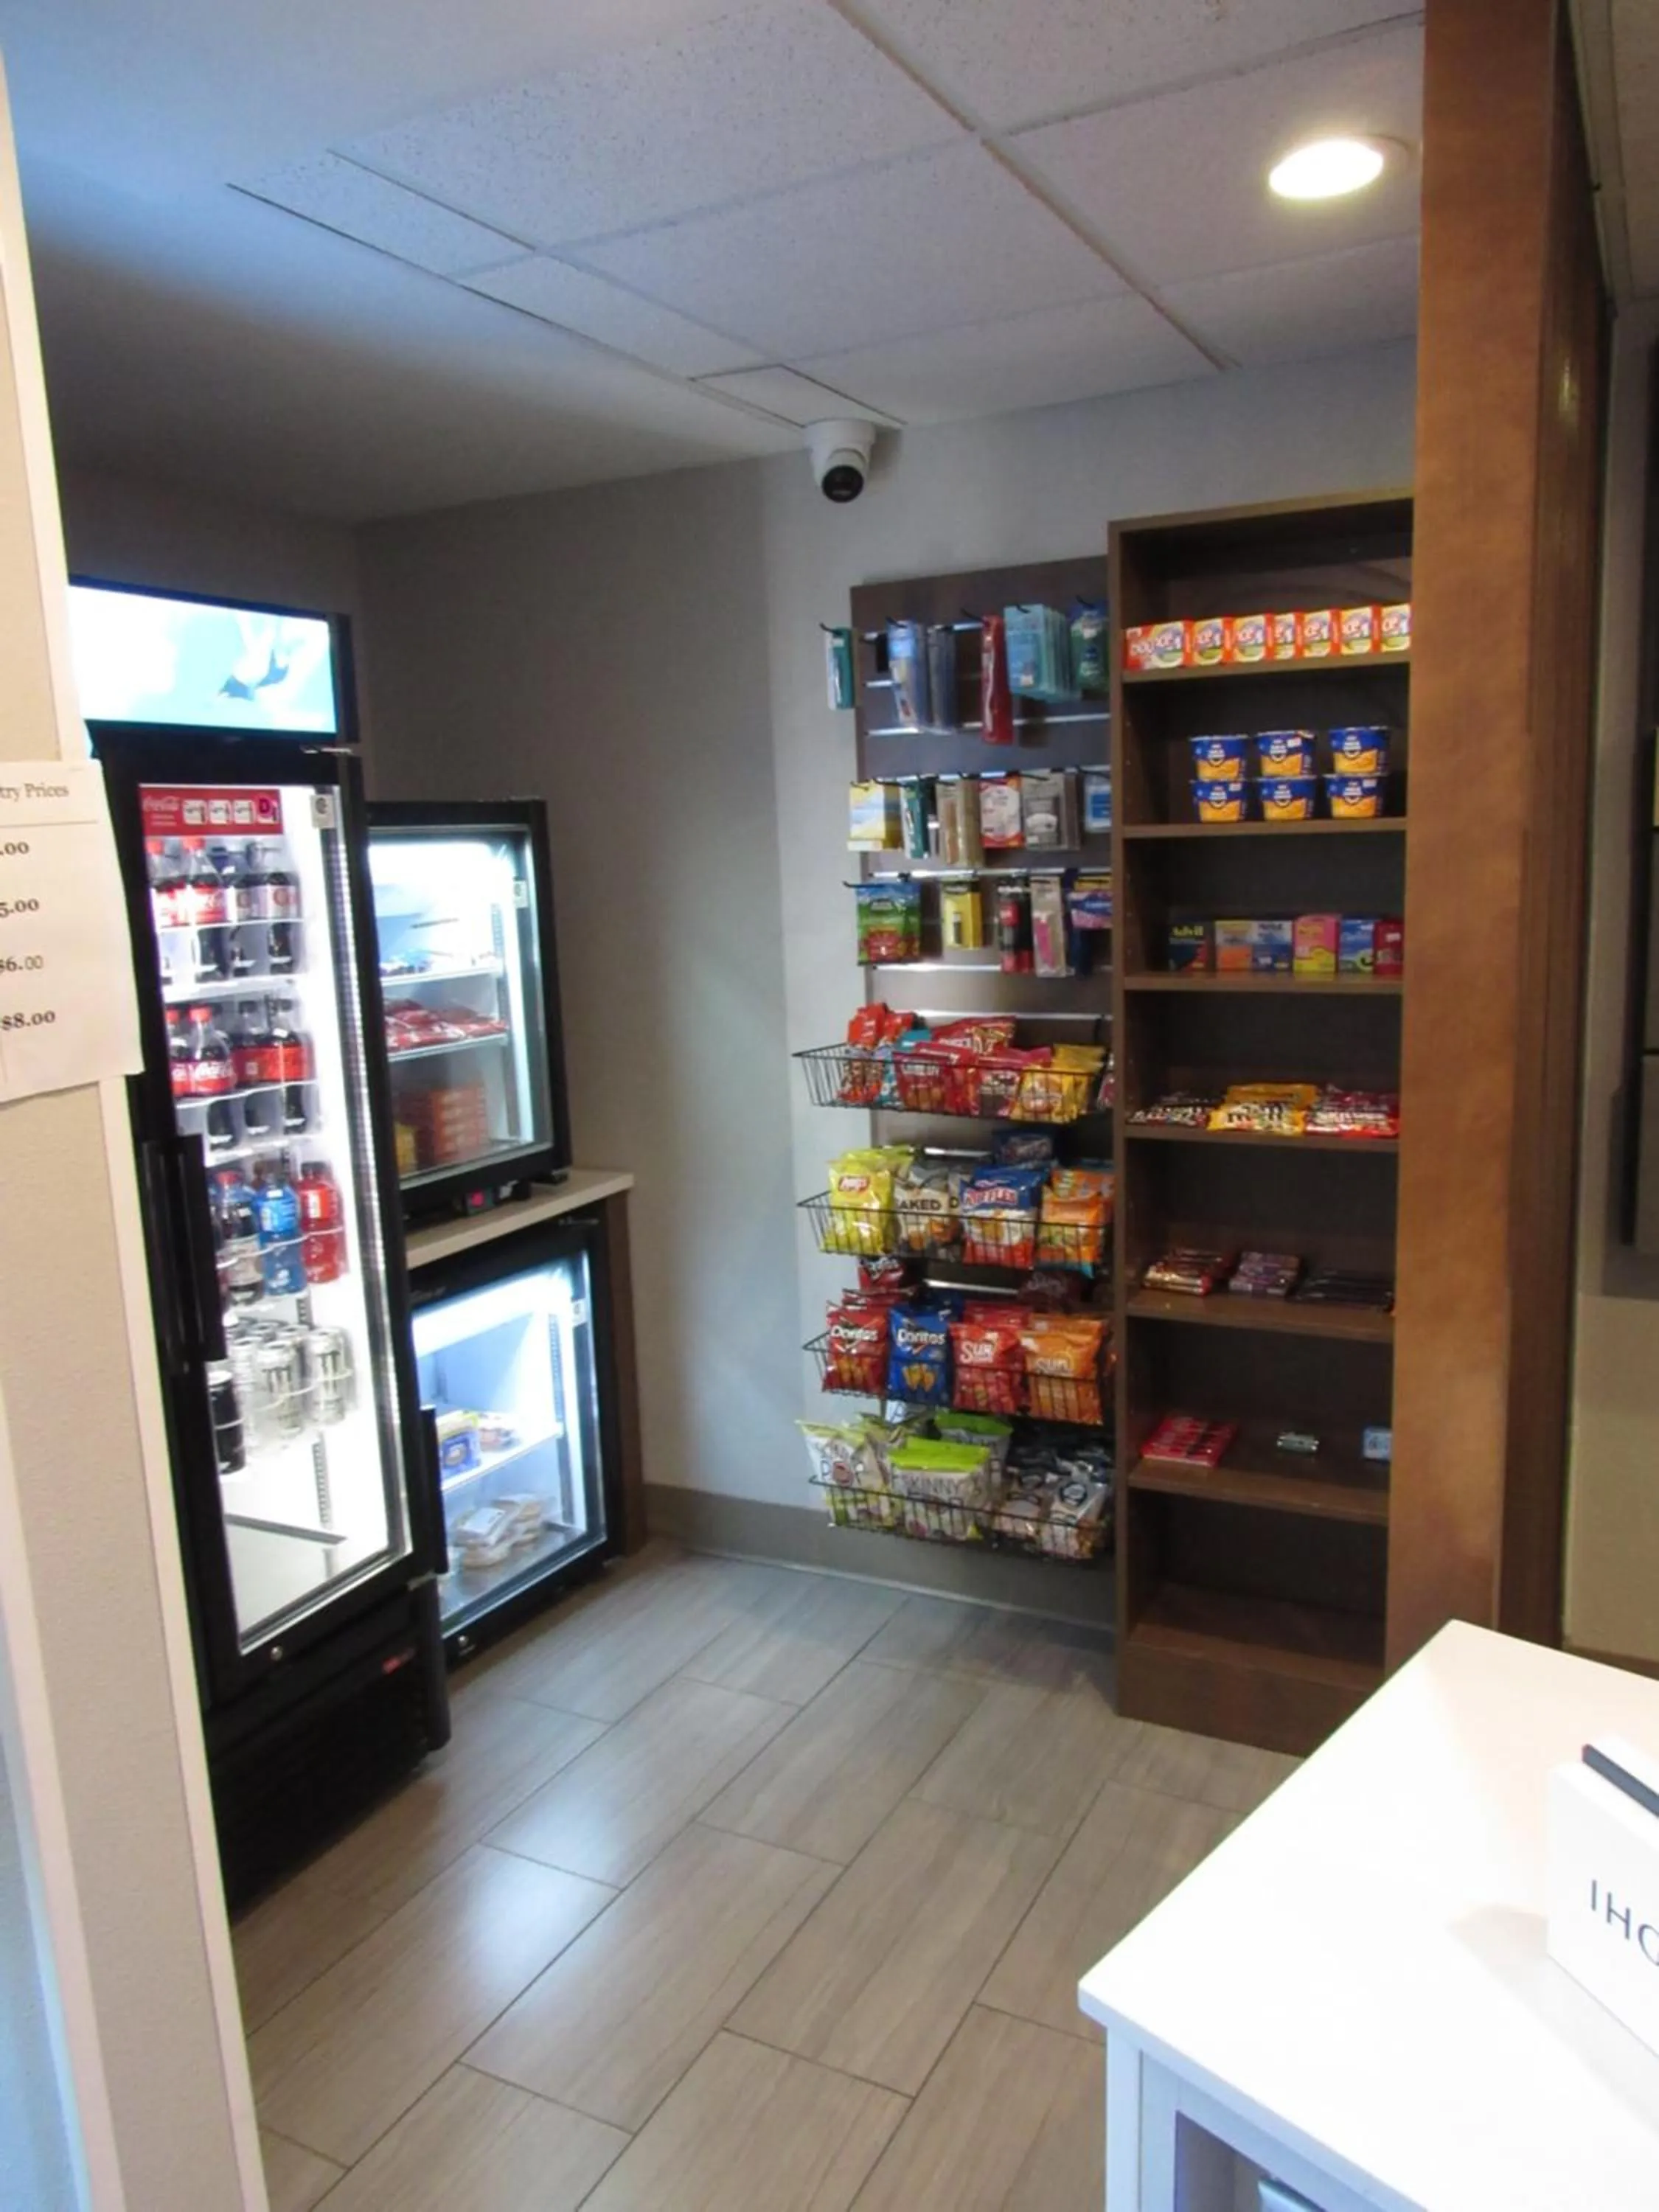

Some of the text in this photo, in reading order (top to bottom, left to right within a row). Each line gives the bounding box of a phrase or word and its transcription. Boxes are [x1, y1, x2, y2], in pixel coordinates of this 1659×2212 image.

[24, 782, 69, 799] Prices
[1, 1010, 56, 1031] $8.00
[895, 1198, 942, 1211] AKED
[830, 1325, 879, 1341] Doritos
[897, 1328, 946, 1346] Doritos
